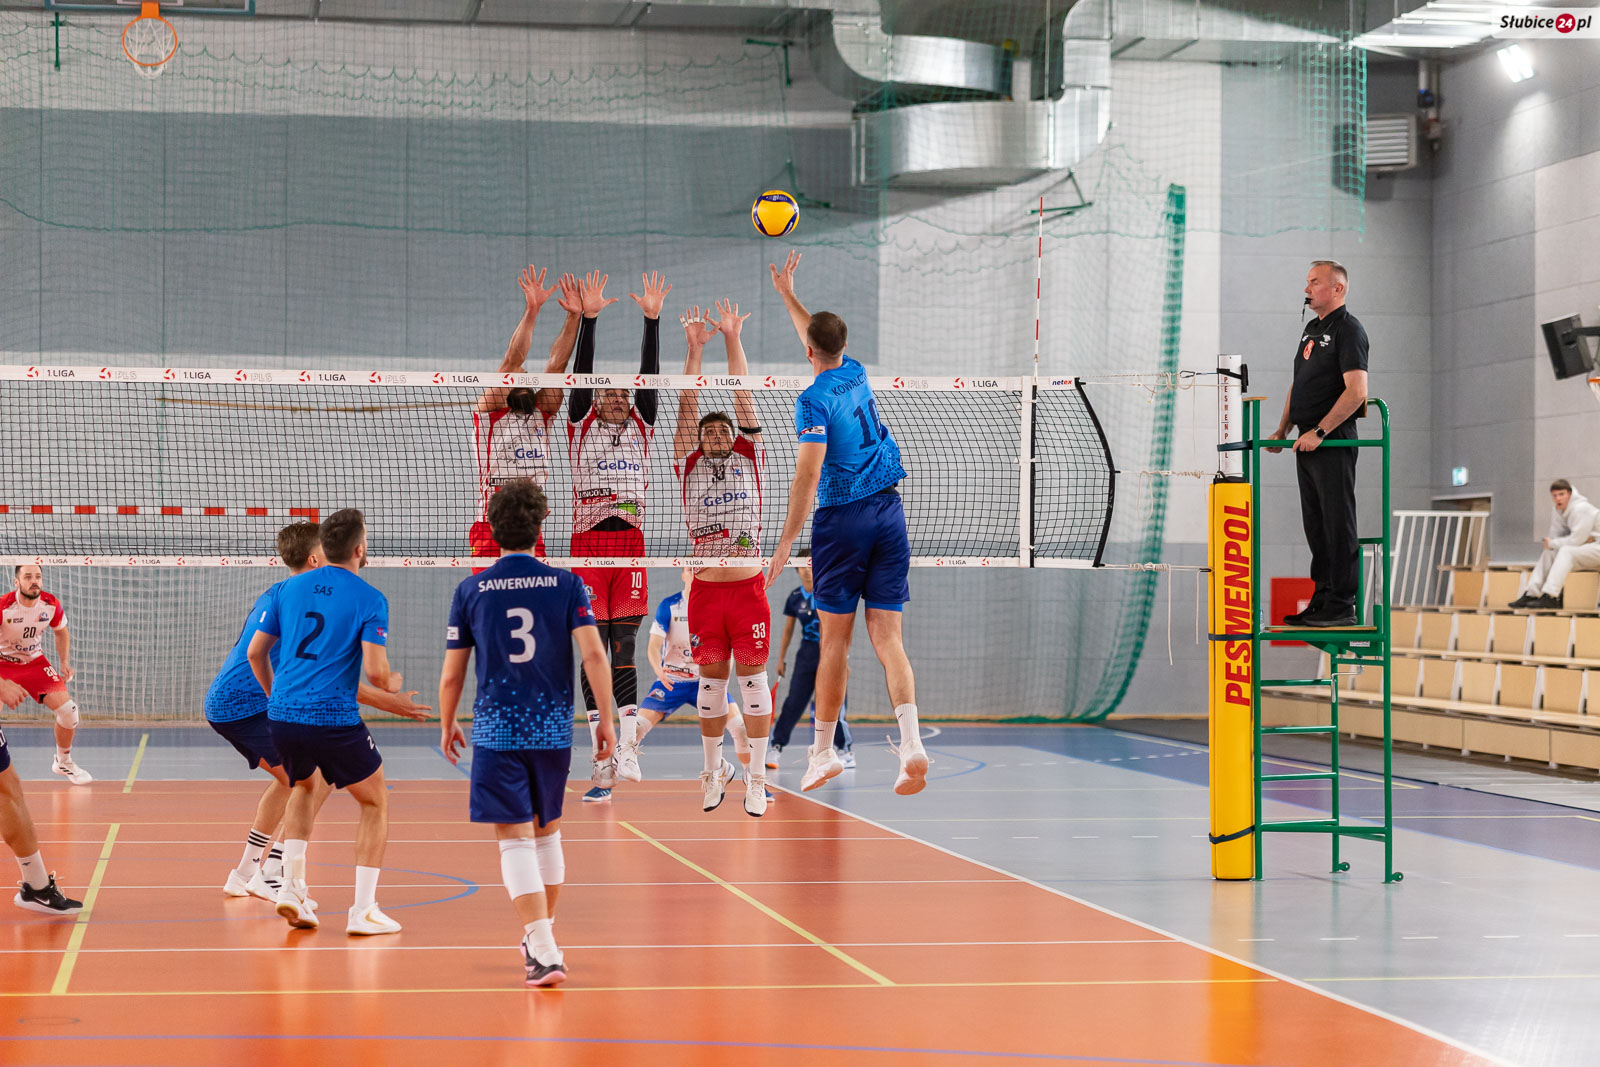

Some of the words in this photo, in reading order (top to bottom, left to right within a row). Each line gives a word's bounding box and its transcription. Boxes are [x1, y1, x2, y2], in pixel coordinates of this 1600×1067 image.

[1051, 378, 1073, 387] netex
[598, 460, 640, 472] GeDro
[704, 492, 747, 507] GeDro
[478, 576, 558, 592] SAWERWAIN
[631, 572, 642, 588] 10
[313, 584, 333, 596] SAS
[1223, 501, 1250, 707] PESMENPOL
[23, 626, 37, 639] 20
[295, 611, 325, 661] 2
[506, 607, 536, 663] 3
[752, 622, 766, 639] 33
